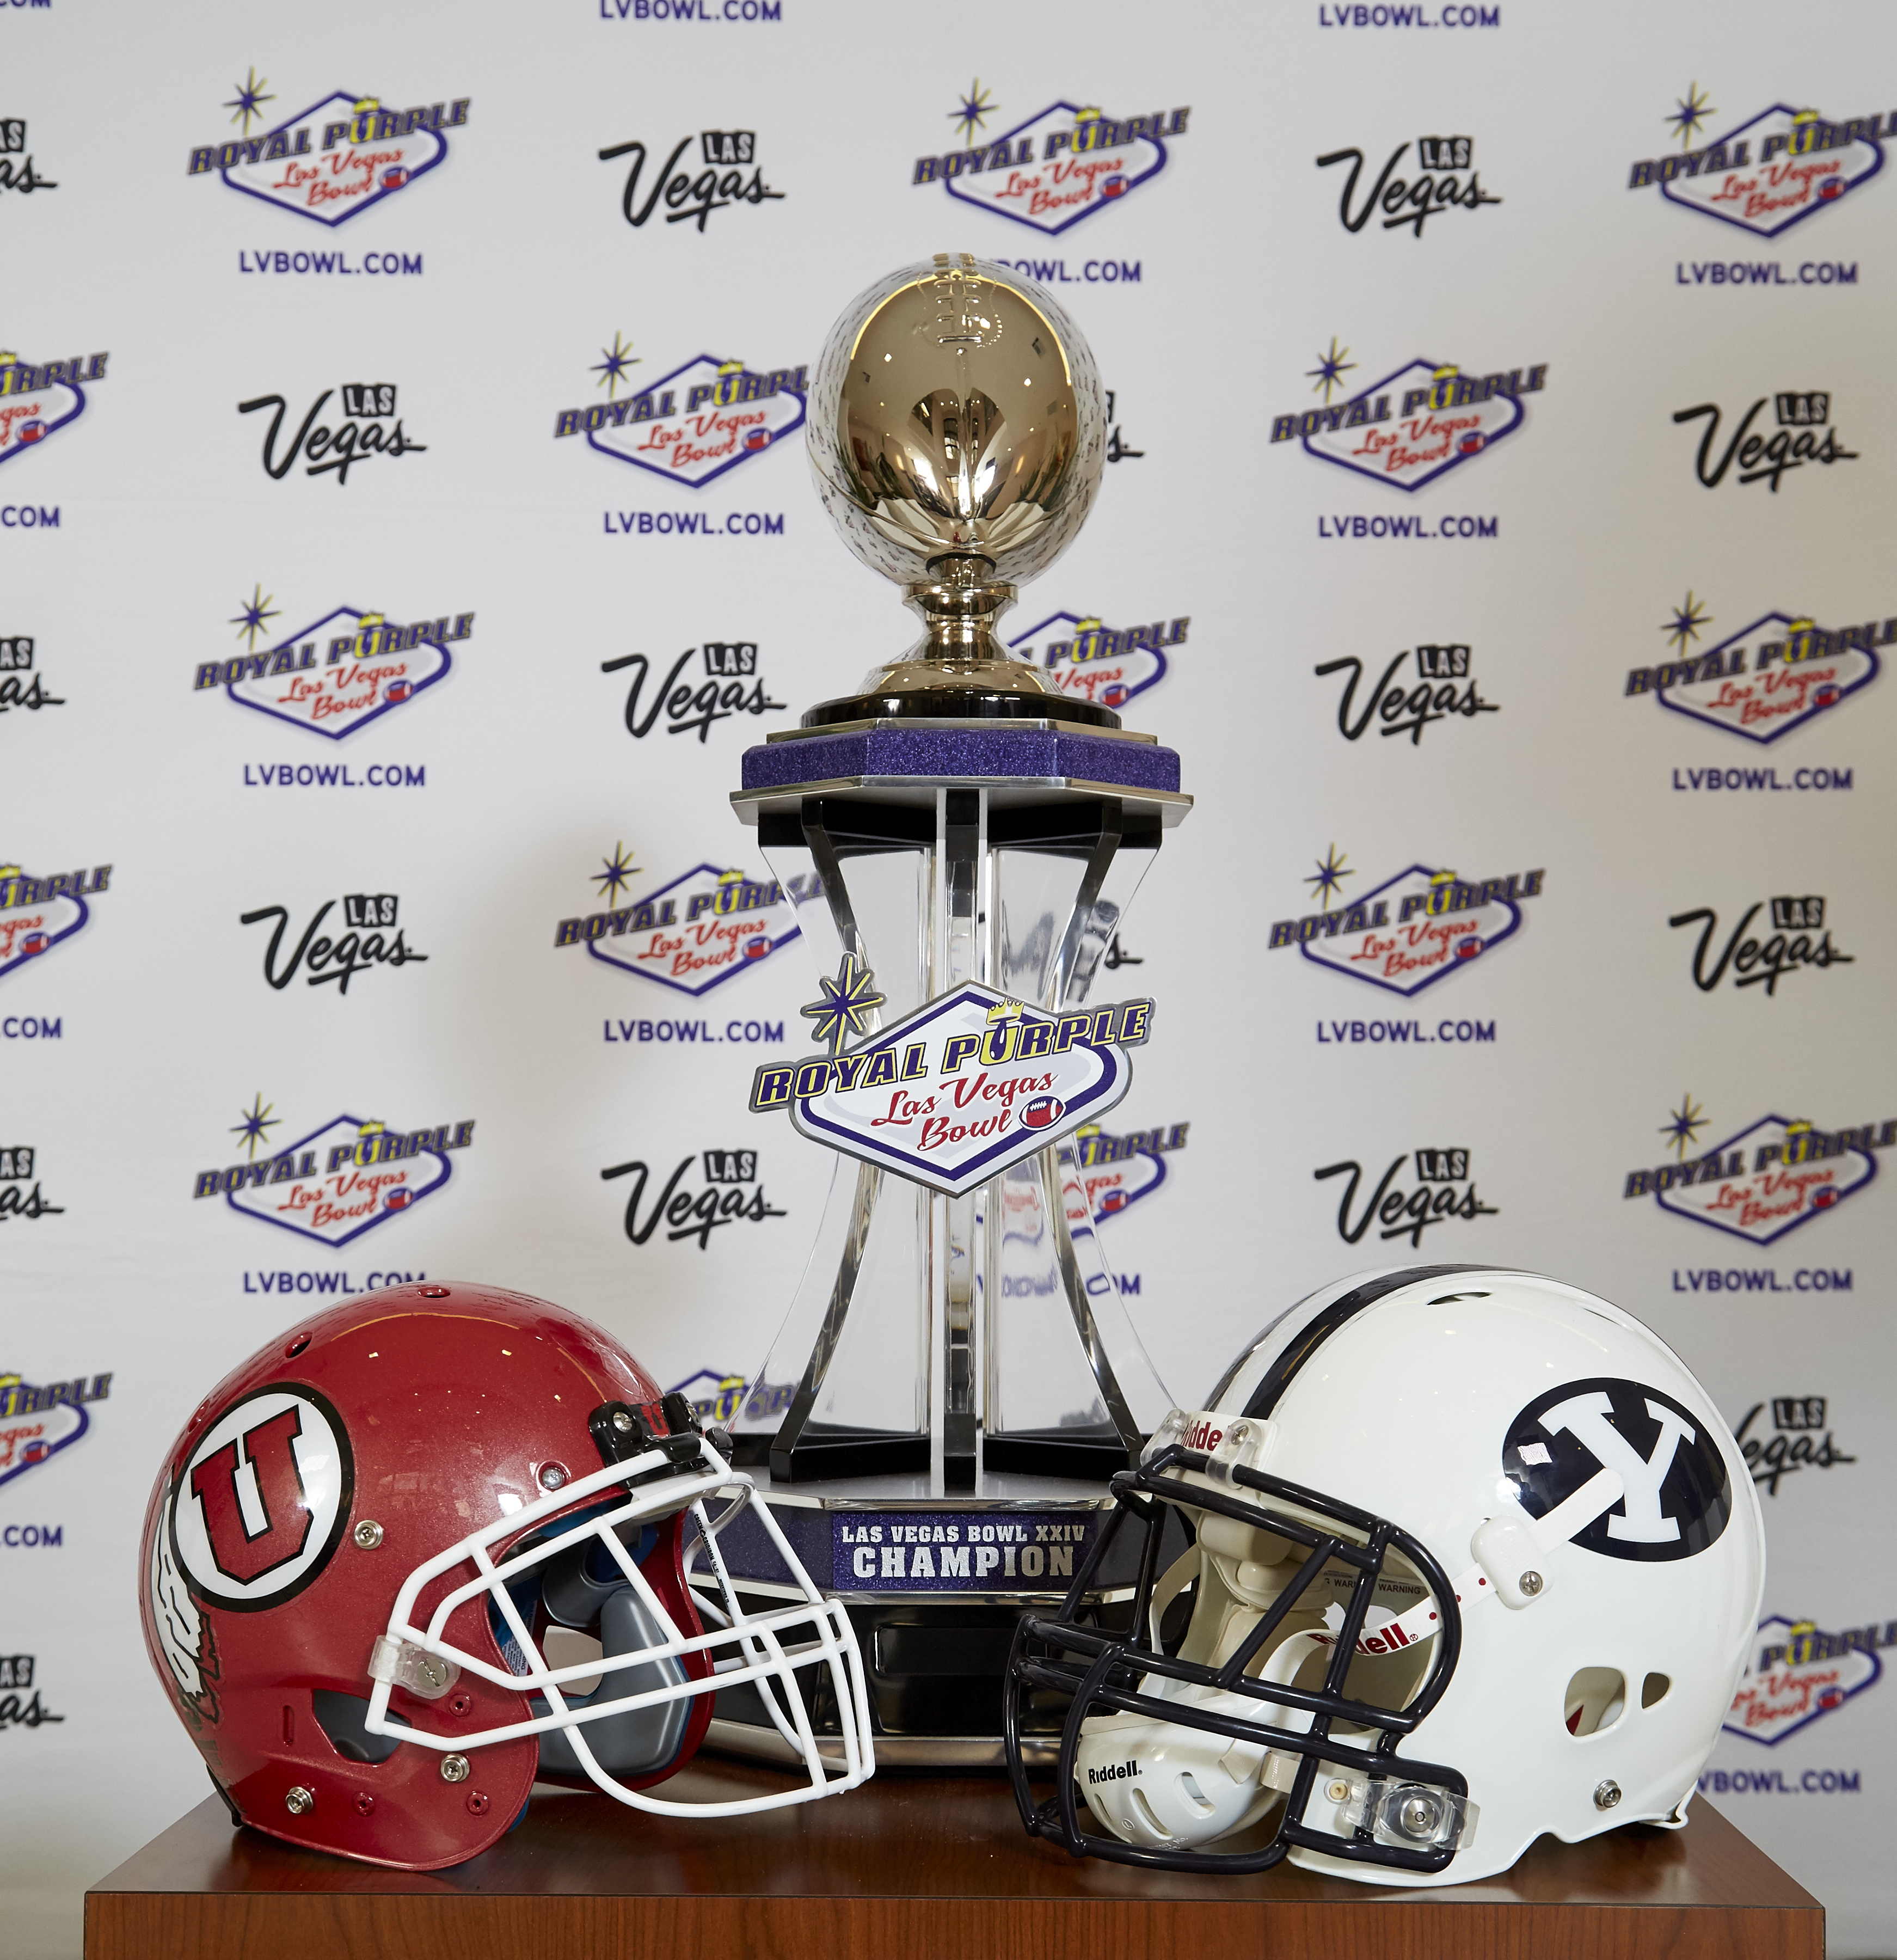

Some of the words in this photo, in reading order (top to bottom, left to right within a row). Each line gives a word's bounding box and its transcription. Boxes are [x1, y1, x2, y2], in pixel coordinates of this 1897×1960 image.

[600, 0, 781, 20] LVBOWL.COM
[1320, 5, 1499, 27] LVBOWL.COM
[188, 128, 311, 175] ROYAL
[322, 96, 471, 150] PURPLE
[705, 133, 753, 163] LAS
[912, 139, 1033, 185] ROYAL
[1043, 107, 1190, 159] PURPLE
[272, 161, 320, 189] Las
[321, 146, 403, 178] Vegas
[1422, 139, 1469, 168] LAS
[1628, 141, 1749, 188] ROYAL
[306, 175, 373, 205] Bowl
[598, 136, 785, 232] Vegas
[995, 170, 1041, 198] Las
[1042, 157, 1124, 187] Vegas
[1316, 142, 1501, 237] Vegas
[1759, 159, 1841, 191] Vegas
[1028, 185, 1094, 214] Bowl
[240, 252, 423, 274] LVBOWL.COM
[996, 260, 1141, 282] OWL.COM
[1677, 262, 1857, 284] LVBOWL.COM
[347, 385, 394, 415] LAS
[554, 391, 676, 438] ROYAL
[686, 365, 809, 412] PURPL
[1270, 396, 1391, 442] ROYAL
[1401, 365, 1547, 416] PURPLE
[1779, 395, 1826, 424] LAS
[239, 388, 427, 485] Vegas
[637, 424, 684, 451] Las
[685, 409, 766, 440] Vegas
[1353, 428, 1399, 455] Las
[1400, 414, 1481, 444] Vegas
[1674, 397, 1858, 492] Vegas
[671, 438, 736, 467] Bowl
[1386, 442, 1451, 471] Bowl
[605, 512, 784, 534] LVBOWL.COM
[1319, 516, 1497, 538] LVBOWL.COM
[0, 639, 31, 669] AS
[195, 644, 316, 690] ROYAL
[327, 612, 474, 664] PURPLE
[1043, 617, 1189, 669] PURPLE
[708, 645, 754, 674] LAS
[1421, 647, 1468, 676] LAS
[1625, 649, 1746, 695] ROYAL
[278, 676, 324, 703] Las
[326, 661, 407, 693] Vegas
[601, 648, 787, 743] Vegas
[1755, 667, 1835, 697] Vegas
[311, 690, 377, 719] Bowl
[1315, 650, 1499, 745] Vegas
[244, 764, 425, 786] LVBOWL.COM
[1674, 768, 1852, 790] LVBOWL.COM
[348, 896, 395, 926] LAS
[555, 901, 676, 946] ROYAL
[1269, 902, 1389, 947] ROYAL
[1398, 871, 1544, 922] PURPLE
[1775, 899, 1822, 928] LAS
[241, 899, 427, 995] Vegas
[638, 932, 684, 960] Las
[685, 918, 766, 949] Vegas
[1351, 933, 1396, 960] Las
[1397, 920, 1478, 950] Vegas
[1669, 902, 1853, 996] Vegas
[671, 946, 736, 976] Bowl
[1384, 947, 1448, 976] Bowl
[605, 1020, 784, 1042] LVBOWL.COM
[1318, 1021, 1495, 1043] LVBOWL.COM
[756, 1042, 927, 1107] ROYAL
[941, 1000, 1152, 1074] PURPLE
[871, 1090, 944, 1126] Las
[940, 1071, 1057, 1106] Vegas
[916, 1110, 1011, 1152] Bowl
[0, 1149, 31, 1178] AS
[195, 1152, 316, 1198] ROYAL
[327, 1120, 474, 1172] PURPLE
[708, 1152, 754, 1181] LAS
[1420, 1151, 1466, 1179] LAS
[1624, 1151, 1744, 1197] ROYAL
[1754, 1120, 1897, 1171] PURPLE
[278, 1184, 324, 1211] Las
[326, 1169, 407, 1200] Vegas
[1753, 1169, 1833, 1199] Vegas
[311, 1198, 377, 1227] Bowl
[601, 1155, 787, 1250] Vegas
[1315, 1154, 1499, 1248] Vegas
[1674, 1270, 1852, 1291] LVBOWL.COM
[1777, 1399, 1823, 1428] LAS
[1537, 1391, 1696, 1543] Y
[190, 1404, 315, 1587] U
[842, 1526, 882, 1543] LAS
[891, 1526, 960, 1542] VEGAS
[967, 1525, 1028, 1542] BOWL
[1035, 1525, 1085, 1542] XXIV
[853, 1546, 1073, 1578] CHAMPION
[1378, 1583, 1421, 1594] WARNING
[0, 1658, 30, 1687] AS
[1088, 1760, 1138, 1784] Riddell
[1697, 1771, 1859, 1793] VBOWL.COM
